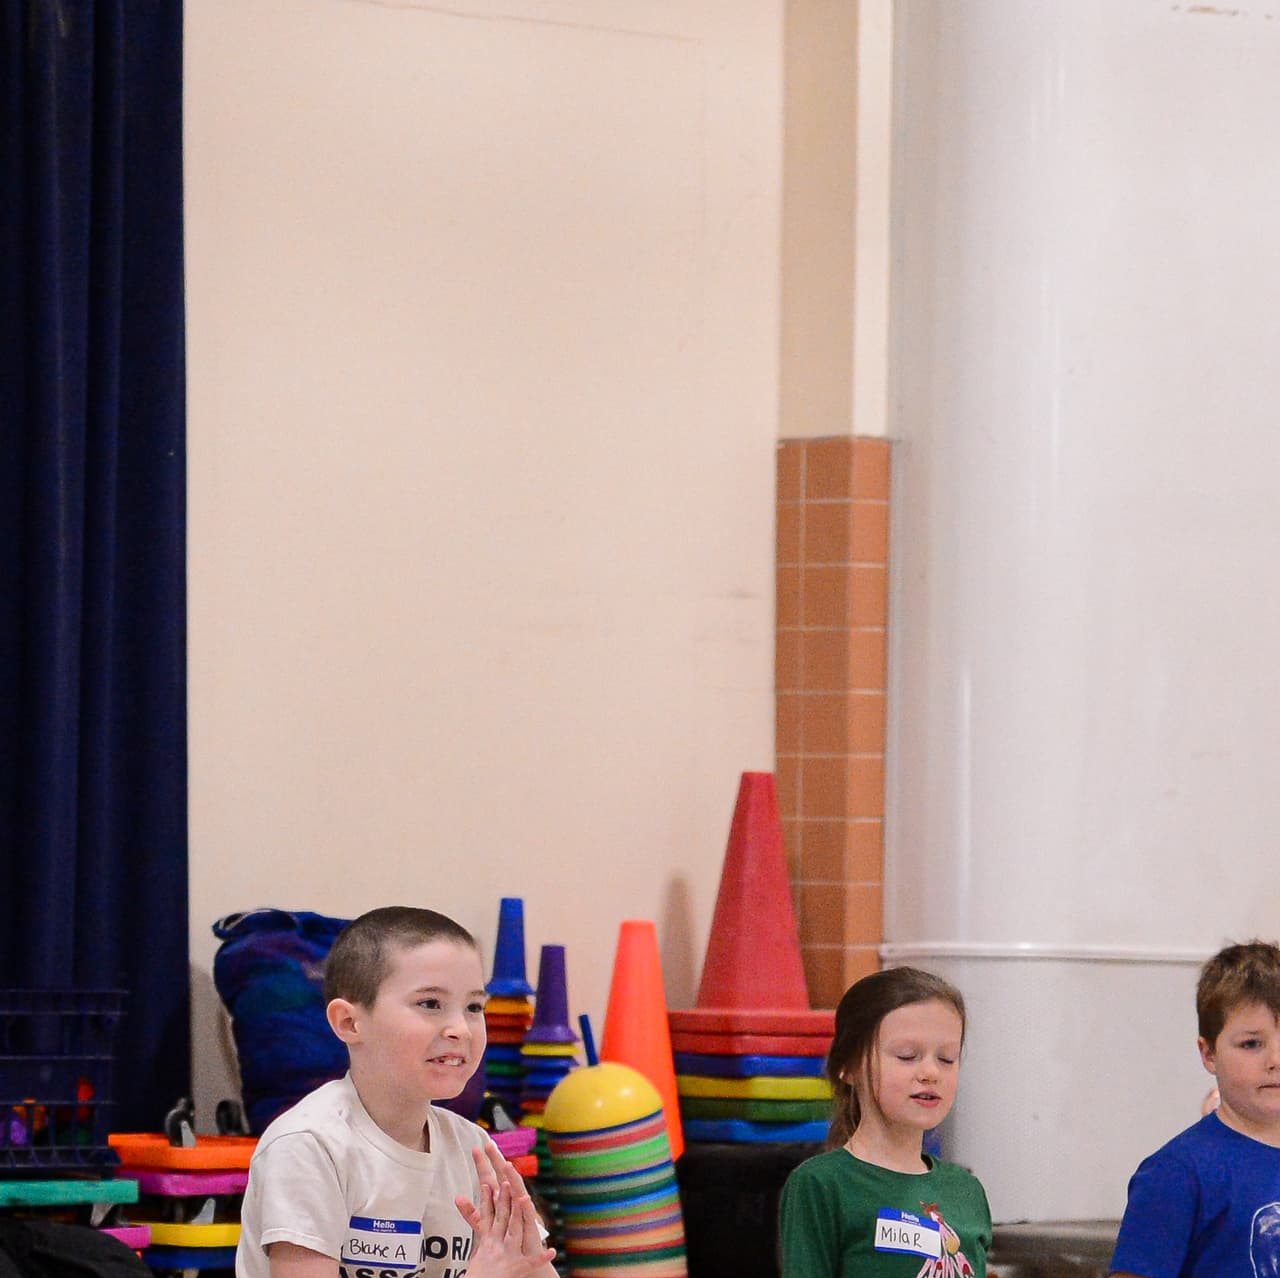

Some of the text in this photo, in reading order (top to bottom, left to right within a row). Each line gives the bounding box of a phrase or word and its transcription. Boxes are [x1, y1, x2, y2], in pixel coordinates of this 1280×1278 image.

[372, 1220, 396, 1230] Hello
[880, 1226, 922, 1248] Mila R
[349, 1238, 407, 1261] Blake A
